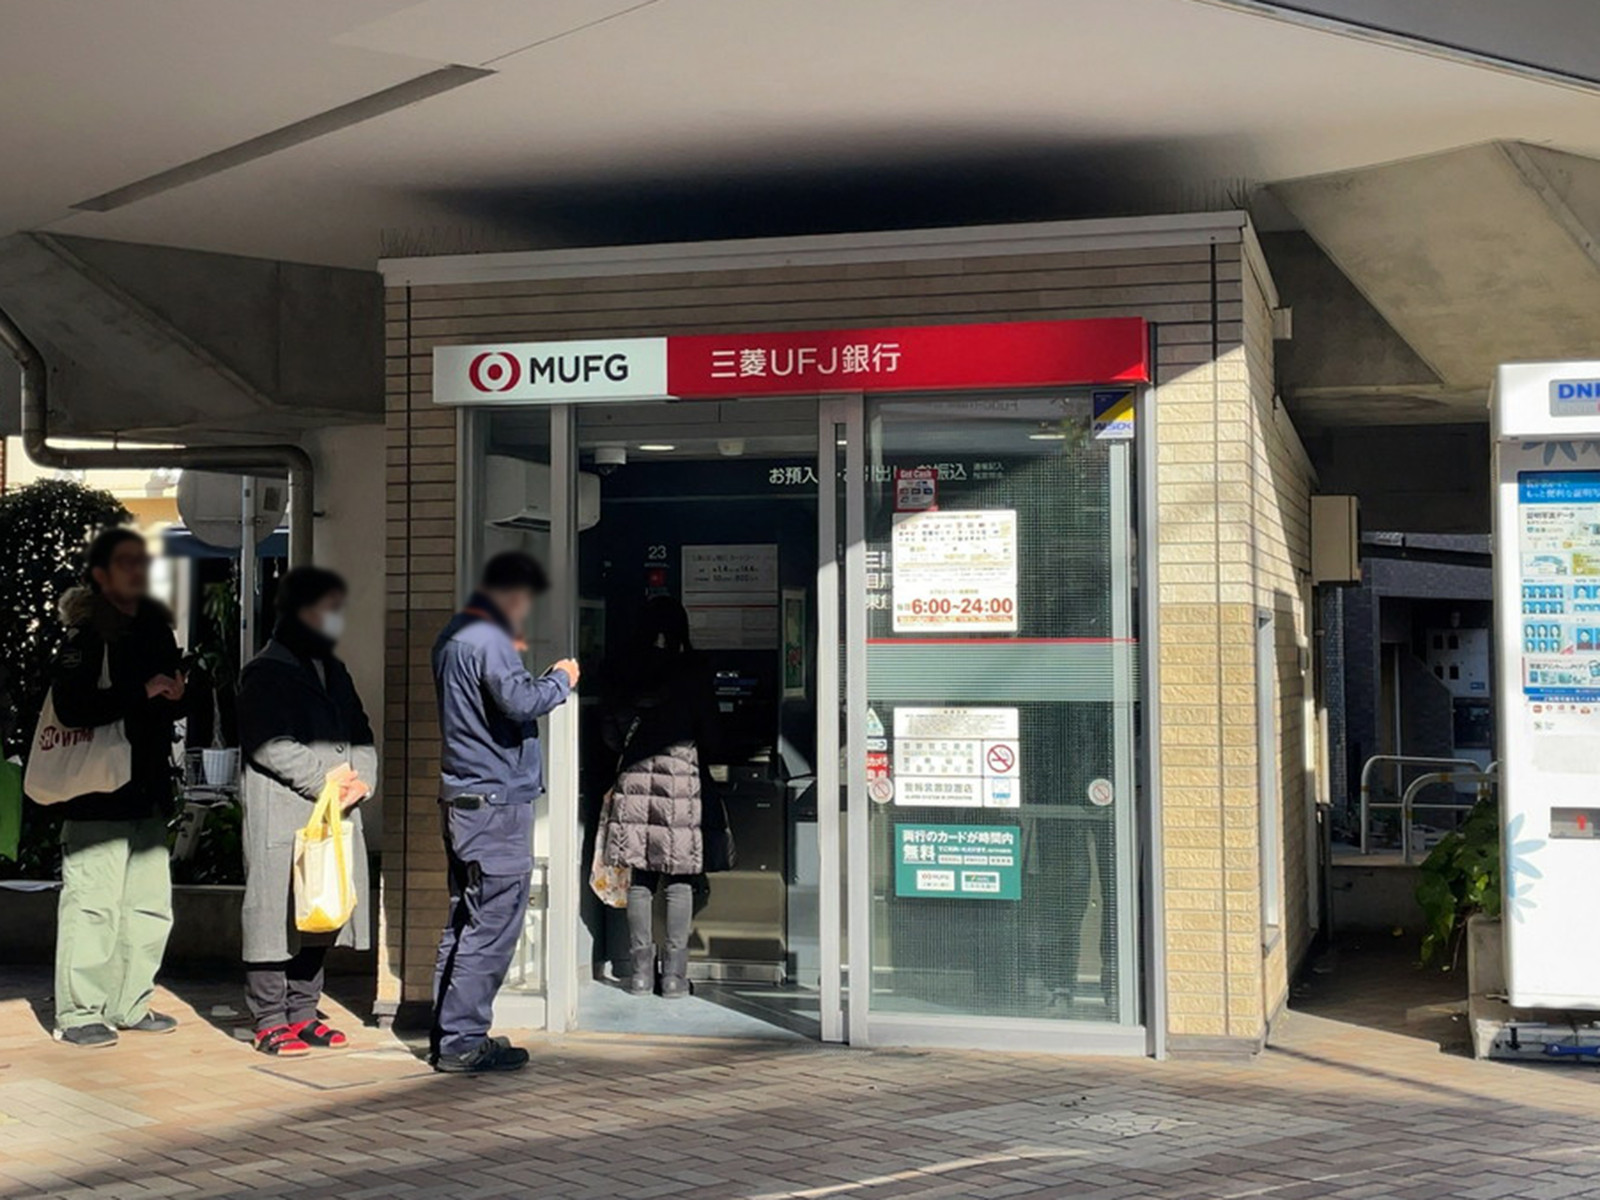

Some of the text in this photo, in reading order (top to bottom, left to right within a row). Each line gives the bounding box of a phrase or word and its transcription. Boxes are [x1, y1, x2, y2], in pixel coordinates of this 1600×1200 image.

[529, 354, 629, 384] MUFG
[711, 342, 902, 378] 三菱UFJ銀行
[648, 545, 667, 559] 23
